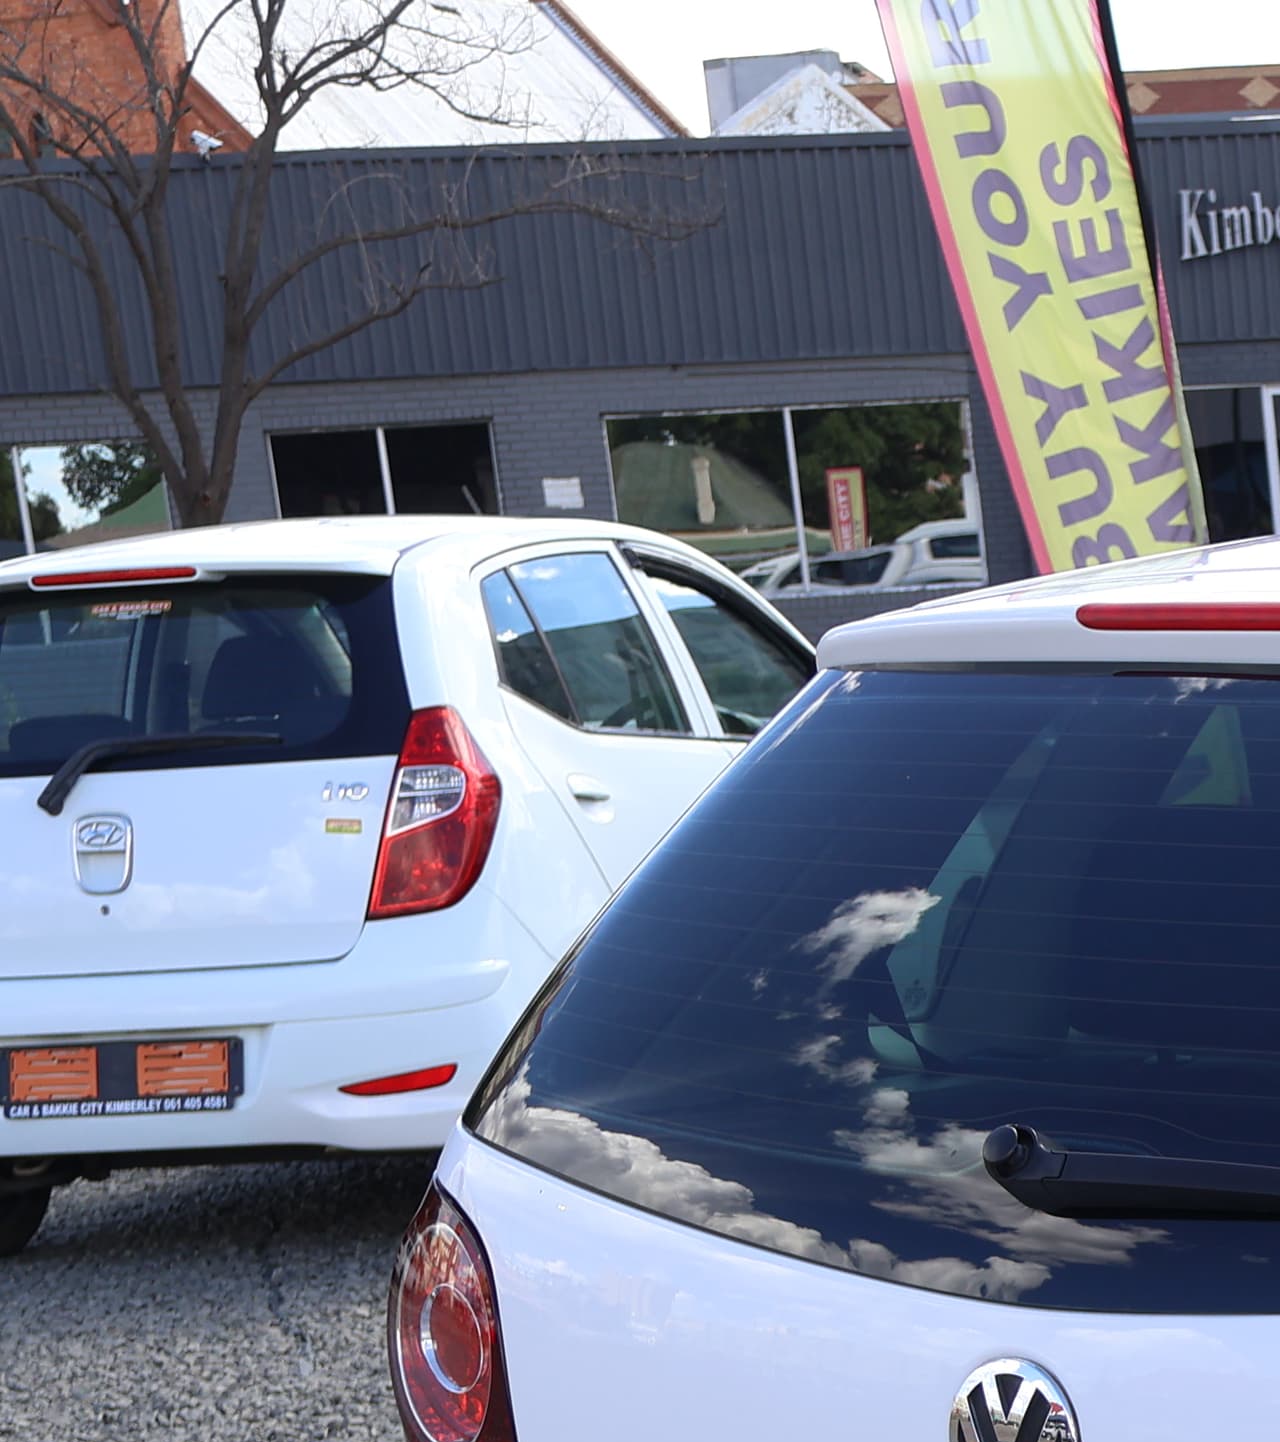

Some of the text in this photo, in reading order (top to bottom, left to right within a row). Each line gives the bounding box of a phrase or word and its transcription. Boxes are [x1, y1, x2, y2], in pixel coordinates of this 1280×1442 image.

[920, 0, 1138, 568] BUY YOUR
[1039, 135, 1196, 543] AKKIES
[10, 1104, 30, 1118] CAR
[42, 1101, 78, 1116] BAKKIE
[80, 1100, 104, 1114] CITY
[105, 1098, 162, 1113] KIMBERLEY
